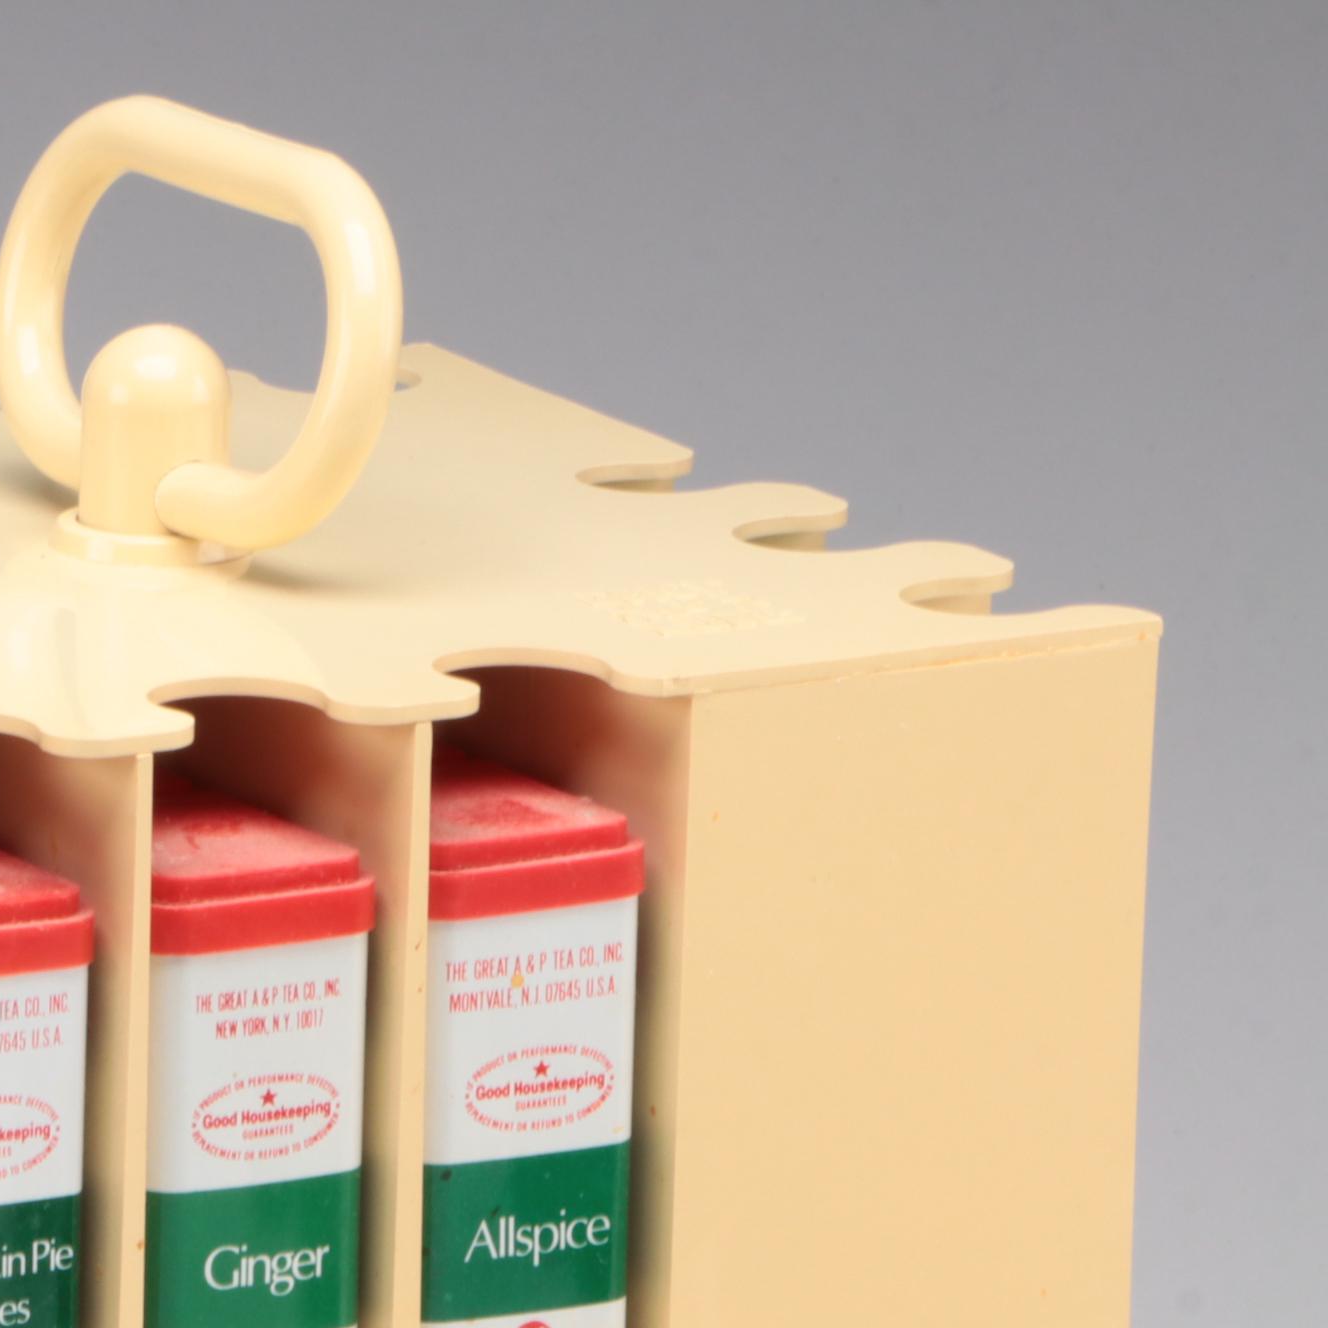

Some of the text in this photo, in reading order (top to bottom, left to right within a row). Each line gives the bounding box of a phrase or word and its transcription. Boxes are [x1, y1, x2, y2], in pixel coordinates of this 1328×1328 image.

[445, 960, 468, 982] THE
[474, 956, 509, 981] GREAT
[525, 953, 535, 975] &
[539, 952, 548, 972] P
[553, 948, 575, 971] TEA
[195, 992, 213, 1013] THE
[218, 989, 248, 1011] GREAT
[252, 988, 259, 1007] A
[272, 984, 279, 1005] P
[283, 983, 299, 1003] TEA
[215, 1019, 238, 1040] NEW
[476, 1072, 605, 1100] Good Housekeeping
[203, 1099, 332, 1130] Good Housekeeping
[463, 1207, 611, 1268] Allspice
[32, 1238, 74, 1274] Pie
[203, 1243, 330, 1297] Ginger
